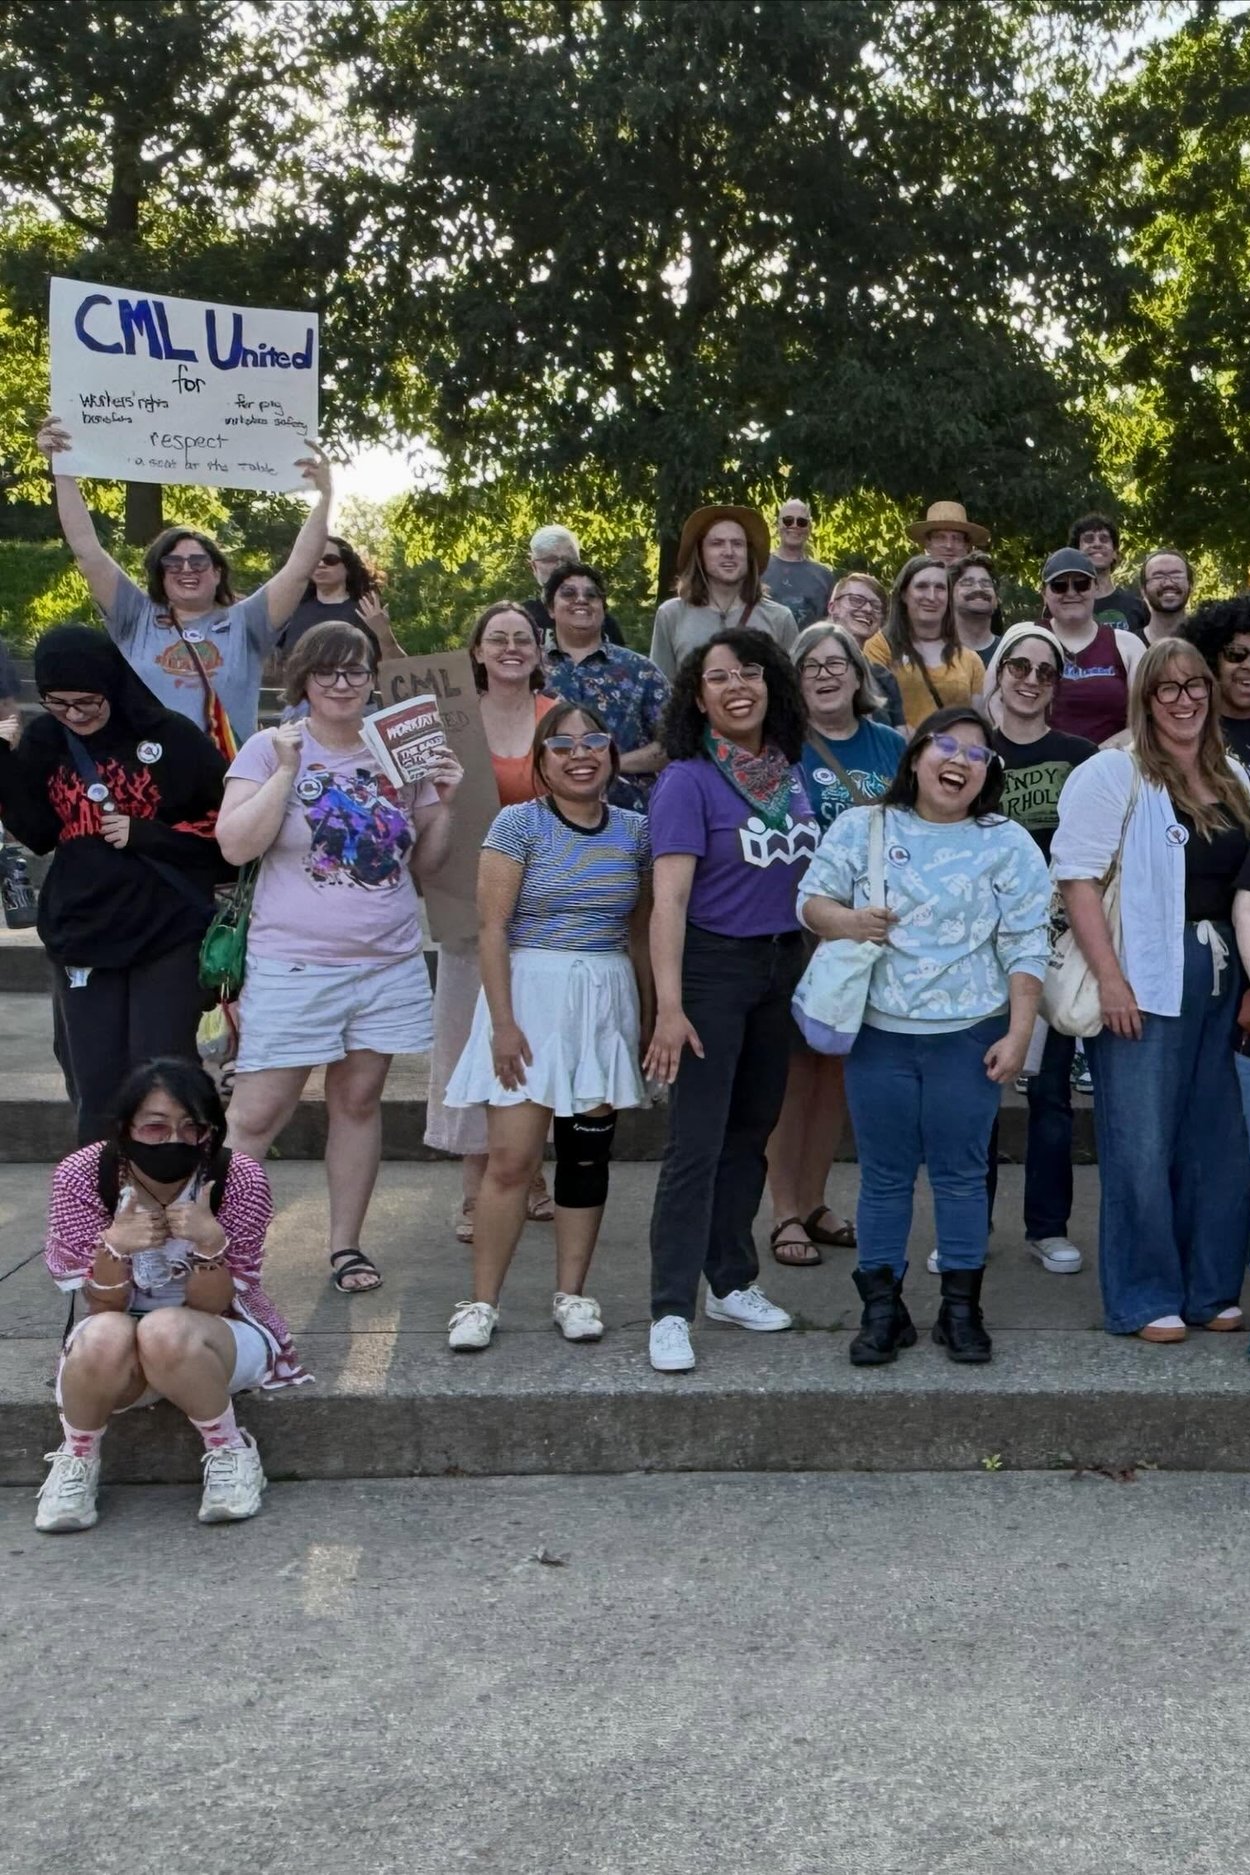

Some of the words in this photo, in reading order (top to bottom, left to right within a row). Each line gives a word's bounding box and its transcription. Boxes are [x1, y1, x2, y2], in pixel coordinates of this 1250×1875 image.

[75, 294, 198, 363] CML
[205, 309, 314, 370] United
[172, 364, 206, 394] for
[149, 431, 230, 464] respect
[391, 668, 462, 701] CML
